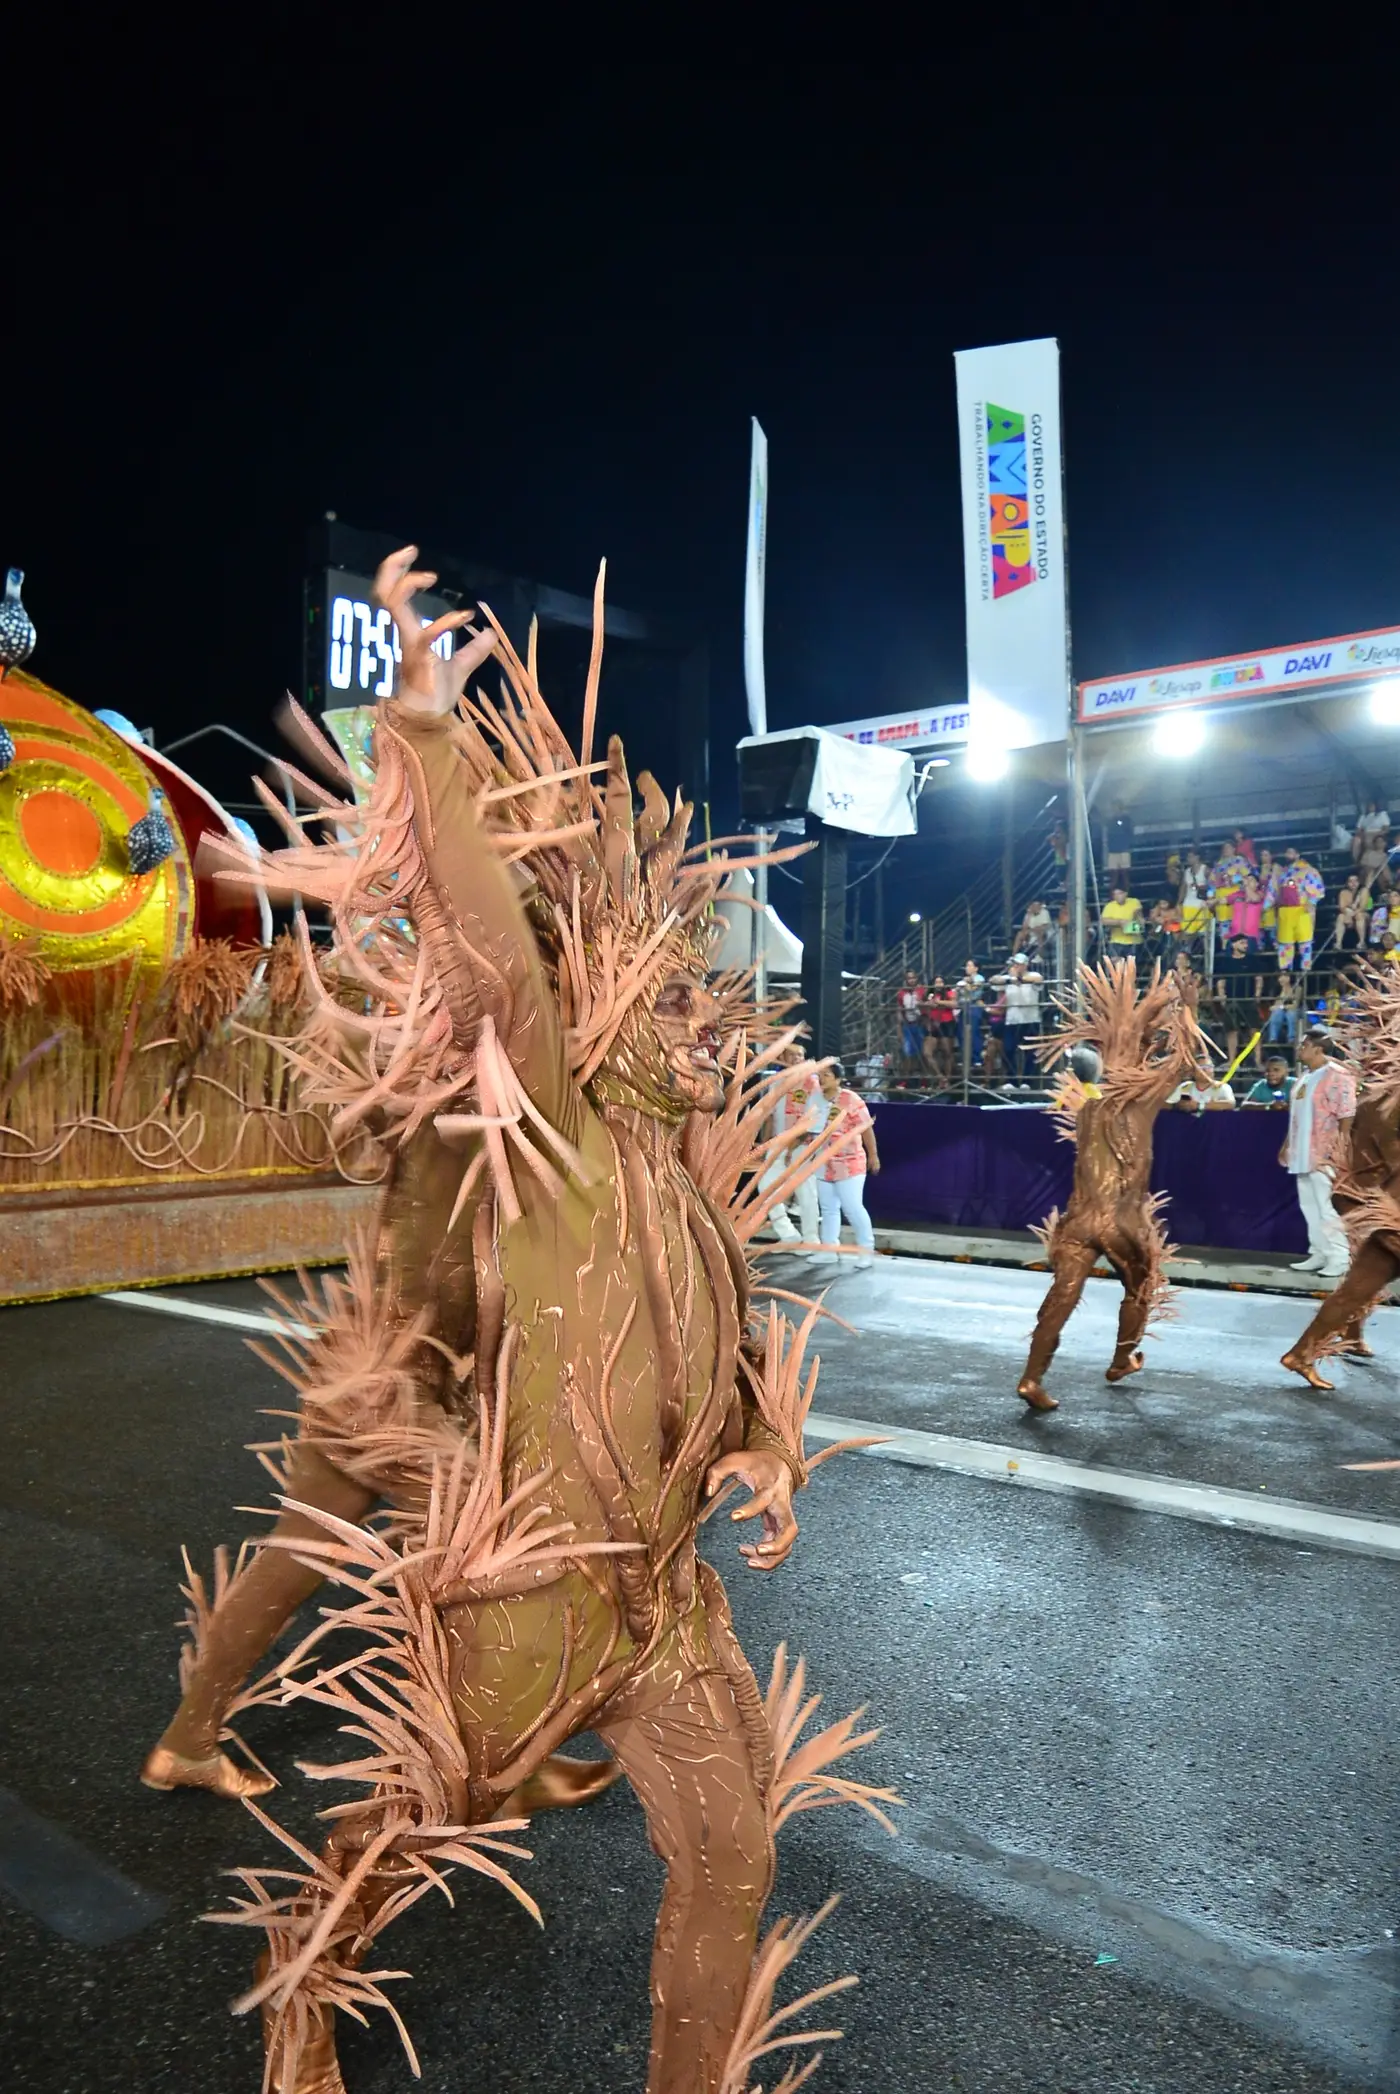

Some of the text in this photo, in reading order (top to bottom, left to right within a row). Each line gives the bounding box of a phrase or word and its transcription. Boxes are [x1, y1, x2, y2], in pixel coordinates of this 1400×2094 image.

[974, 401, 989, 601] TRABALHANDO NA DIREÇÃO CERTA
[1031, 413, 1049, 580] GOVERNO DO ESTADO
[1095, 687, 1136, 707] DAVI
[1283, 652, 1333, 675] DAVI
